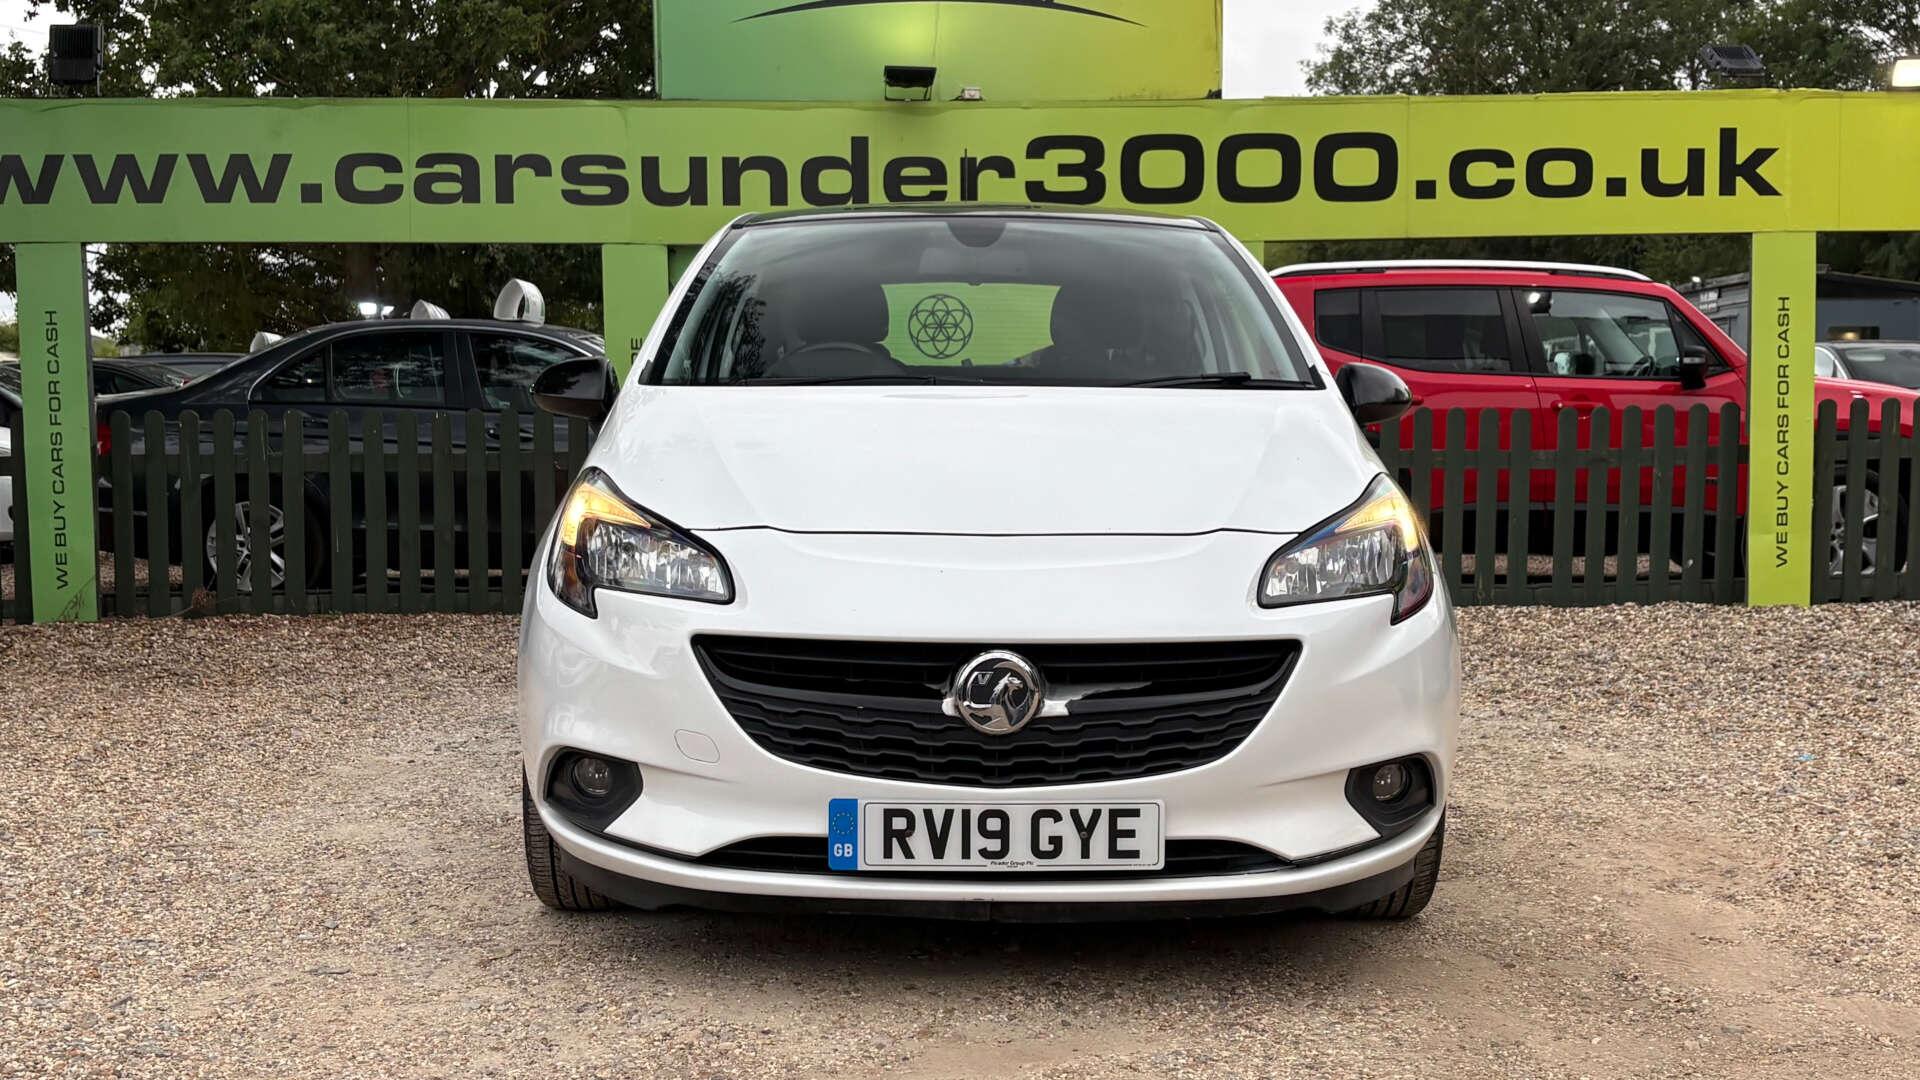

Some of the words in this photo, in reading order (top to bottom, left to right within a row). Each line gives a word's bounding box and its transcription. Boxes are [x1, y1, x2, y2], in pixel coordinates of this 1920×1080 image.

[0, 128, 1782, 206] www.carsunder3000.co.uk
[45, 310, 60, 374] CASH
[1777, 296, 1790, 359] CASH
[48, 380, 62, 426] FOR
[1777, 364, 1790, 409] FOR
[50, 431, 65, 495] CARS
[1777, 415, 1789, 475] CARS
[52, 499, 67, 548] BUY
[1776, 481, 1789, 527] BUY
[54, 552, 69, 590] WE
[1775, 531, 1788, 568] WE
[833, 843, 853, 857] GB
[883, 808, 1010, 860] RV19
[1030, 808, 1141, 860] GYE
